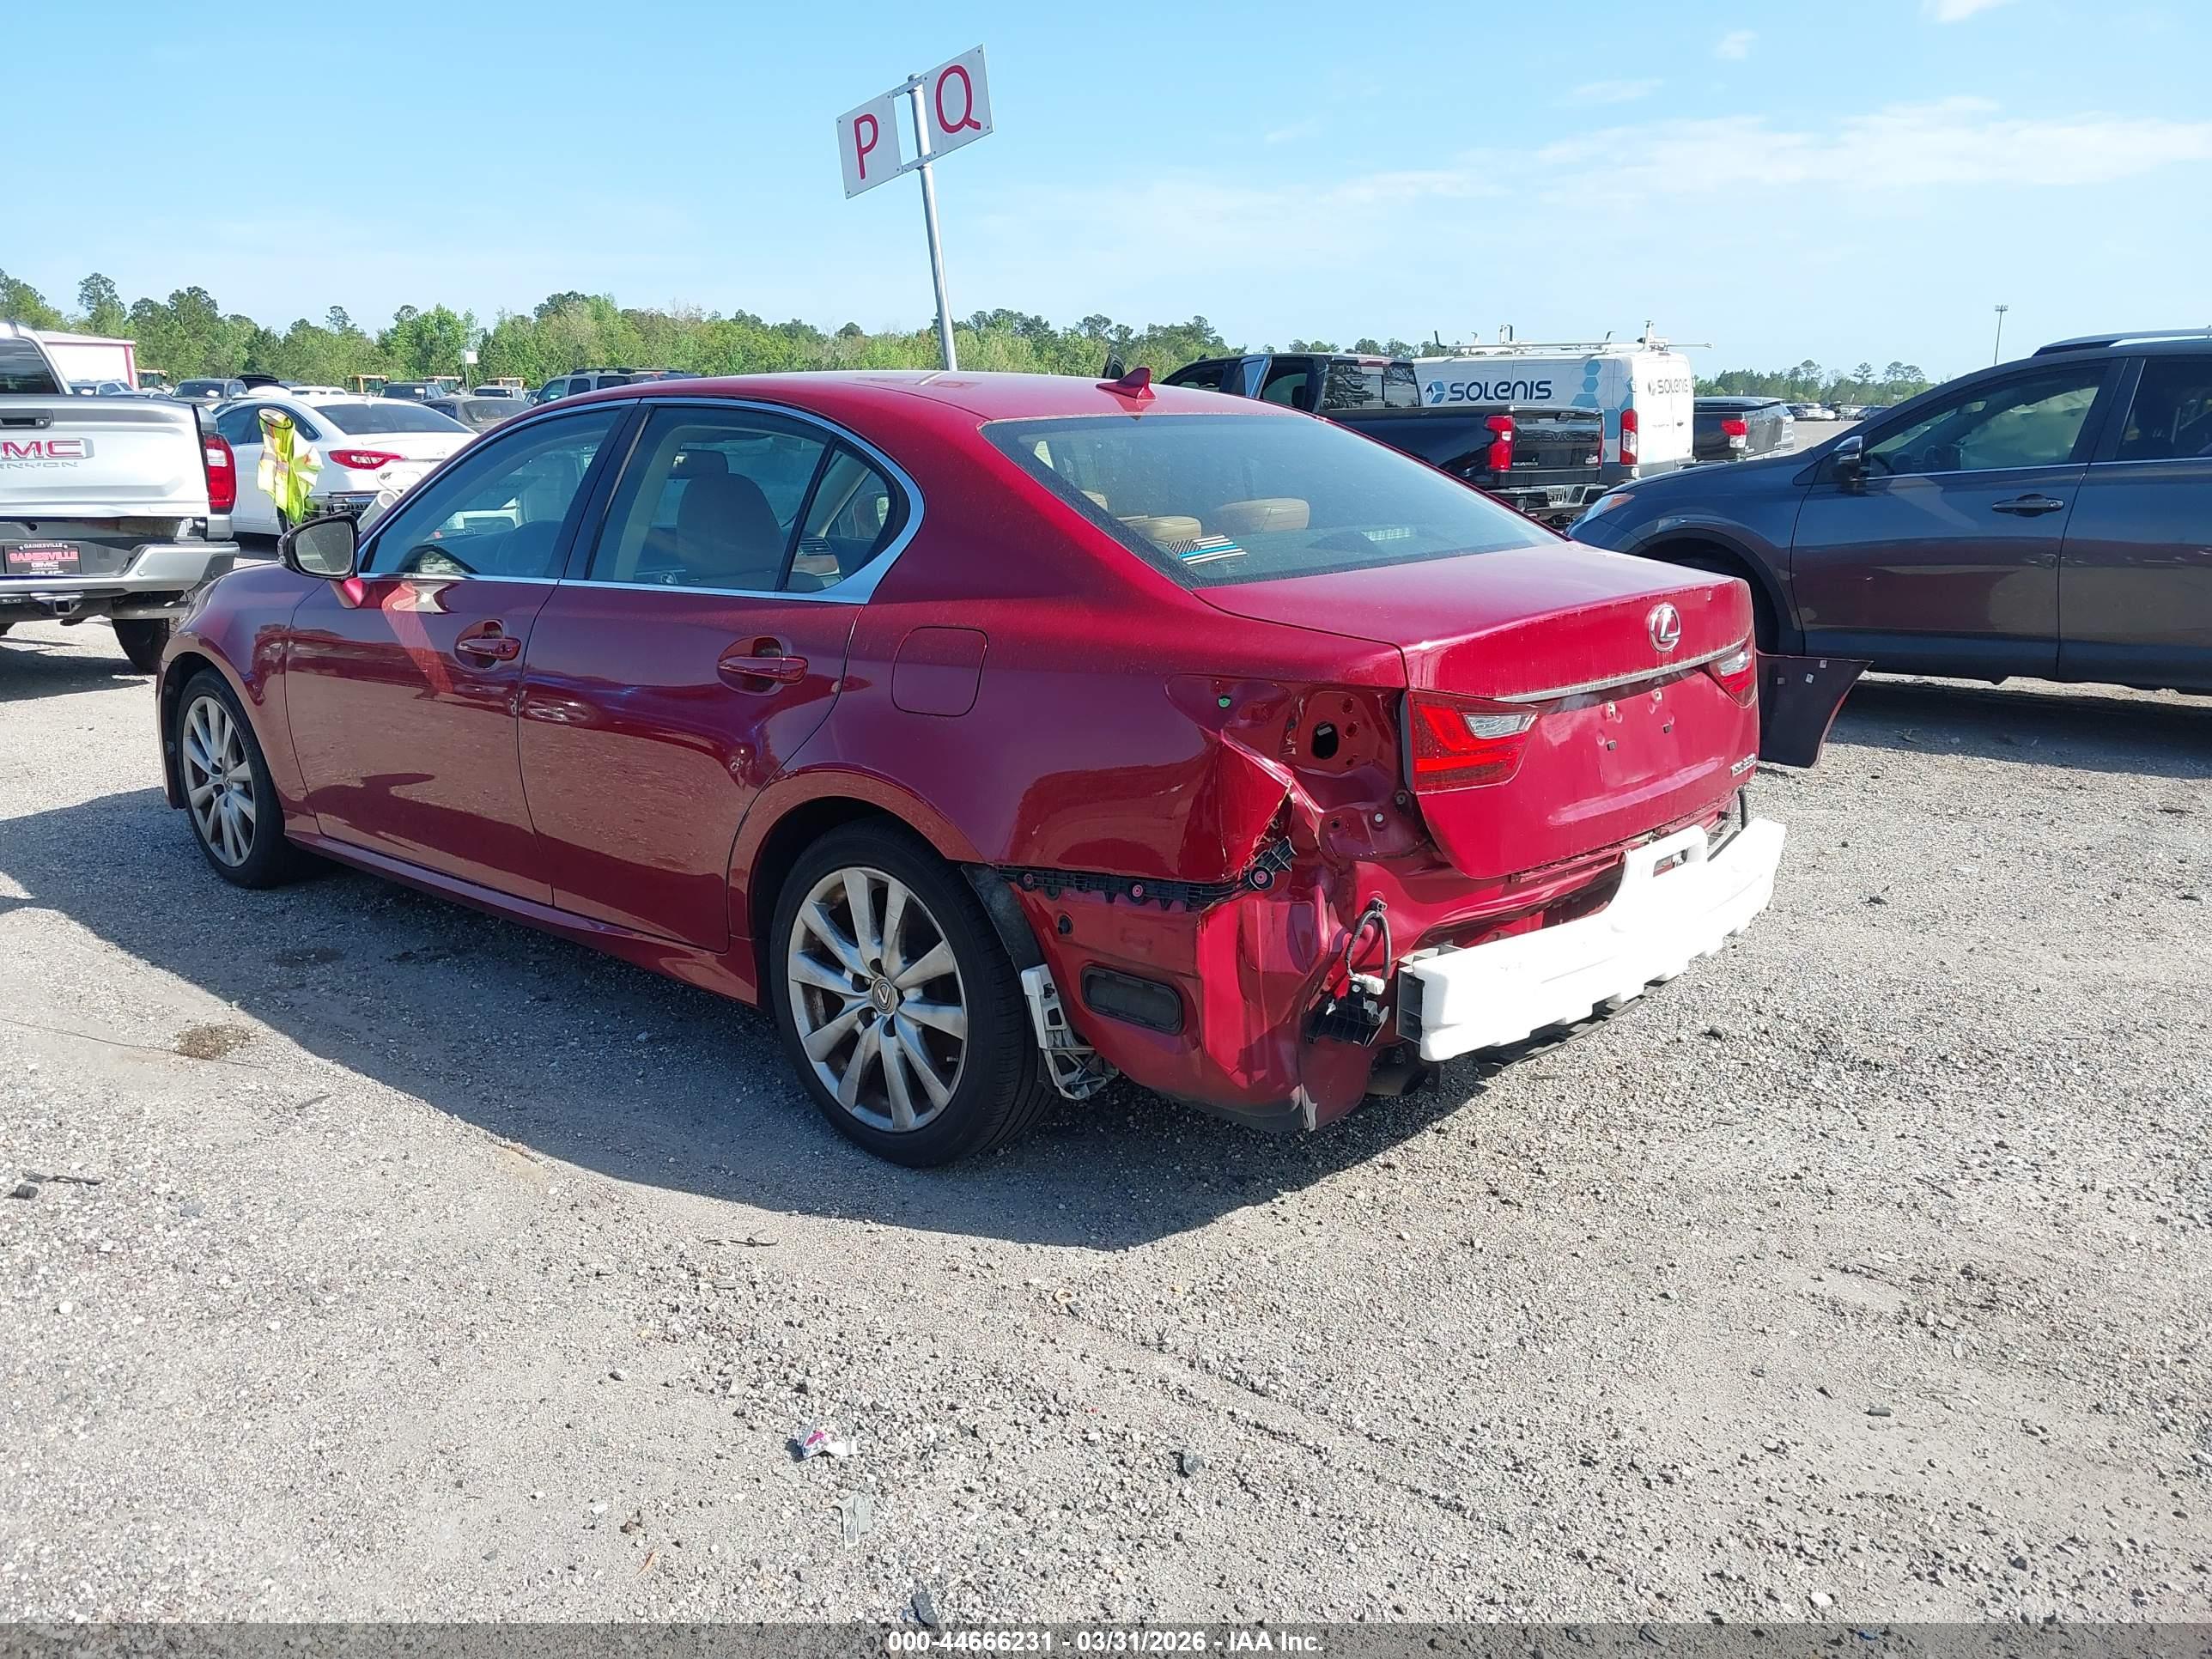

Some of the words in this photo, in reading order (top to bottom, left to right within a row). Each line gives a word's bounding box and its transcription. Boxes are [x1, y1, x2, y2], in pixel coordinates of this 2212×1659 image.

[936, 65, 981, 133] Q
[854, 114, 878, 179] P
[0, 440, 83, 459] MC
